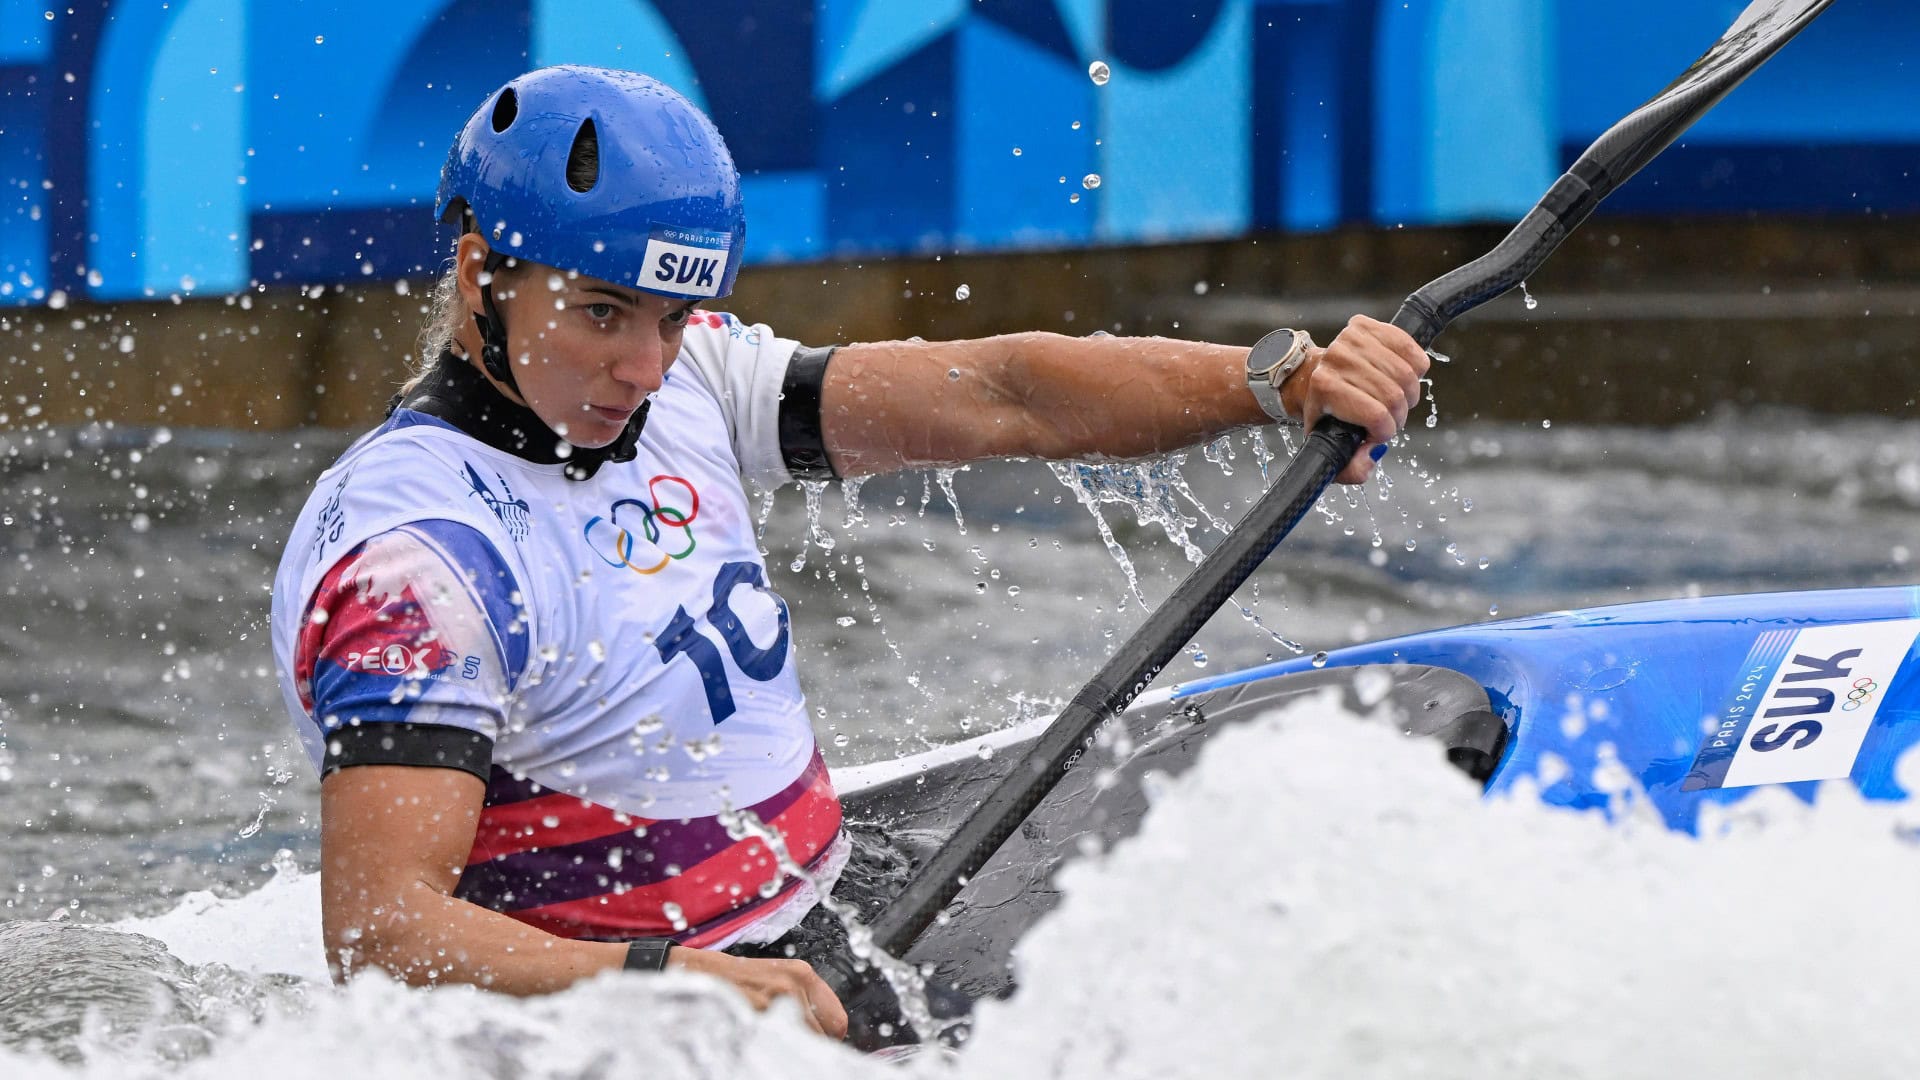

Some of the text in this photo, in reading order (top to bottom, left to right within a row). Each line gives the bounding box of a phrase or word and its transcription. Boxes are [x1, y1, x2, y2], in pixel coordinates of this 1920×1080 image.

[655, 252, 719, 287] SUK
[654, 561, 789, 726] 10
[1735, 665, 1768, 702] 2024
[1750, 648, 1863, 752] SUK
